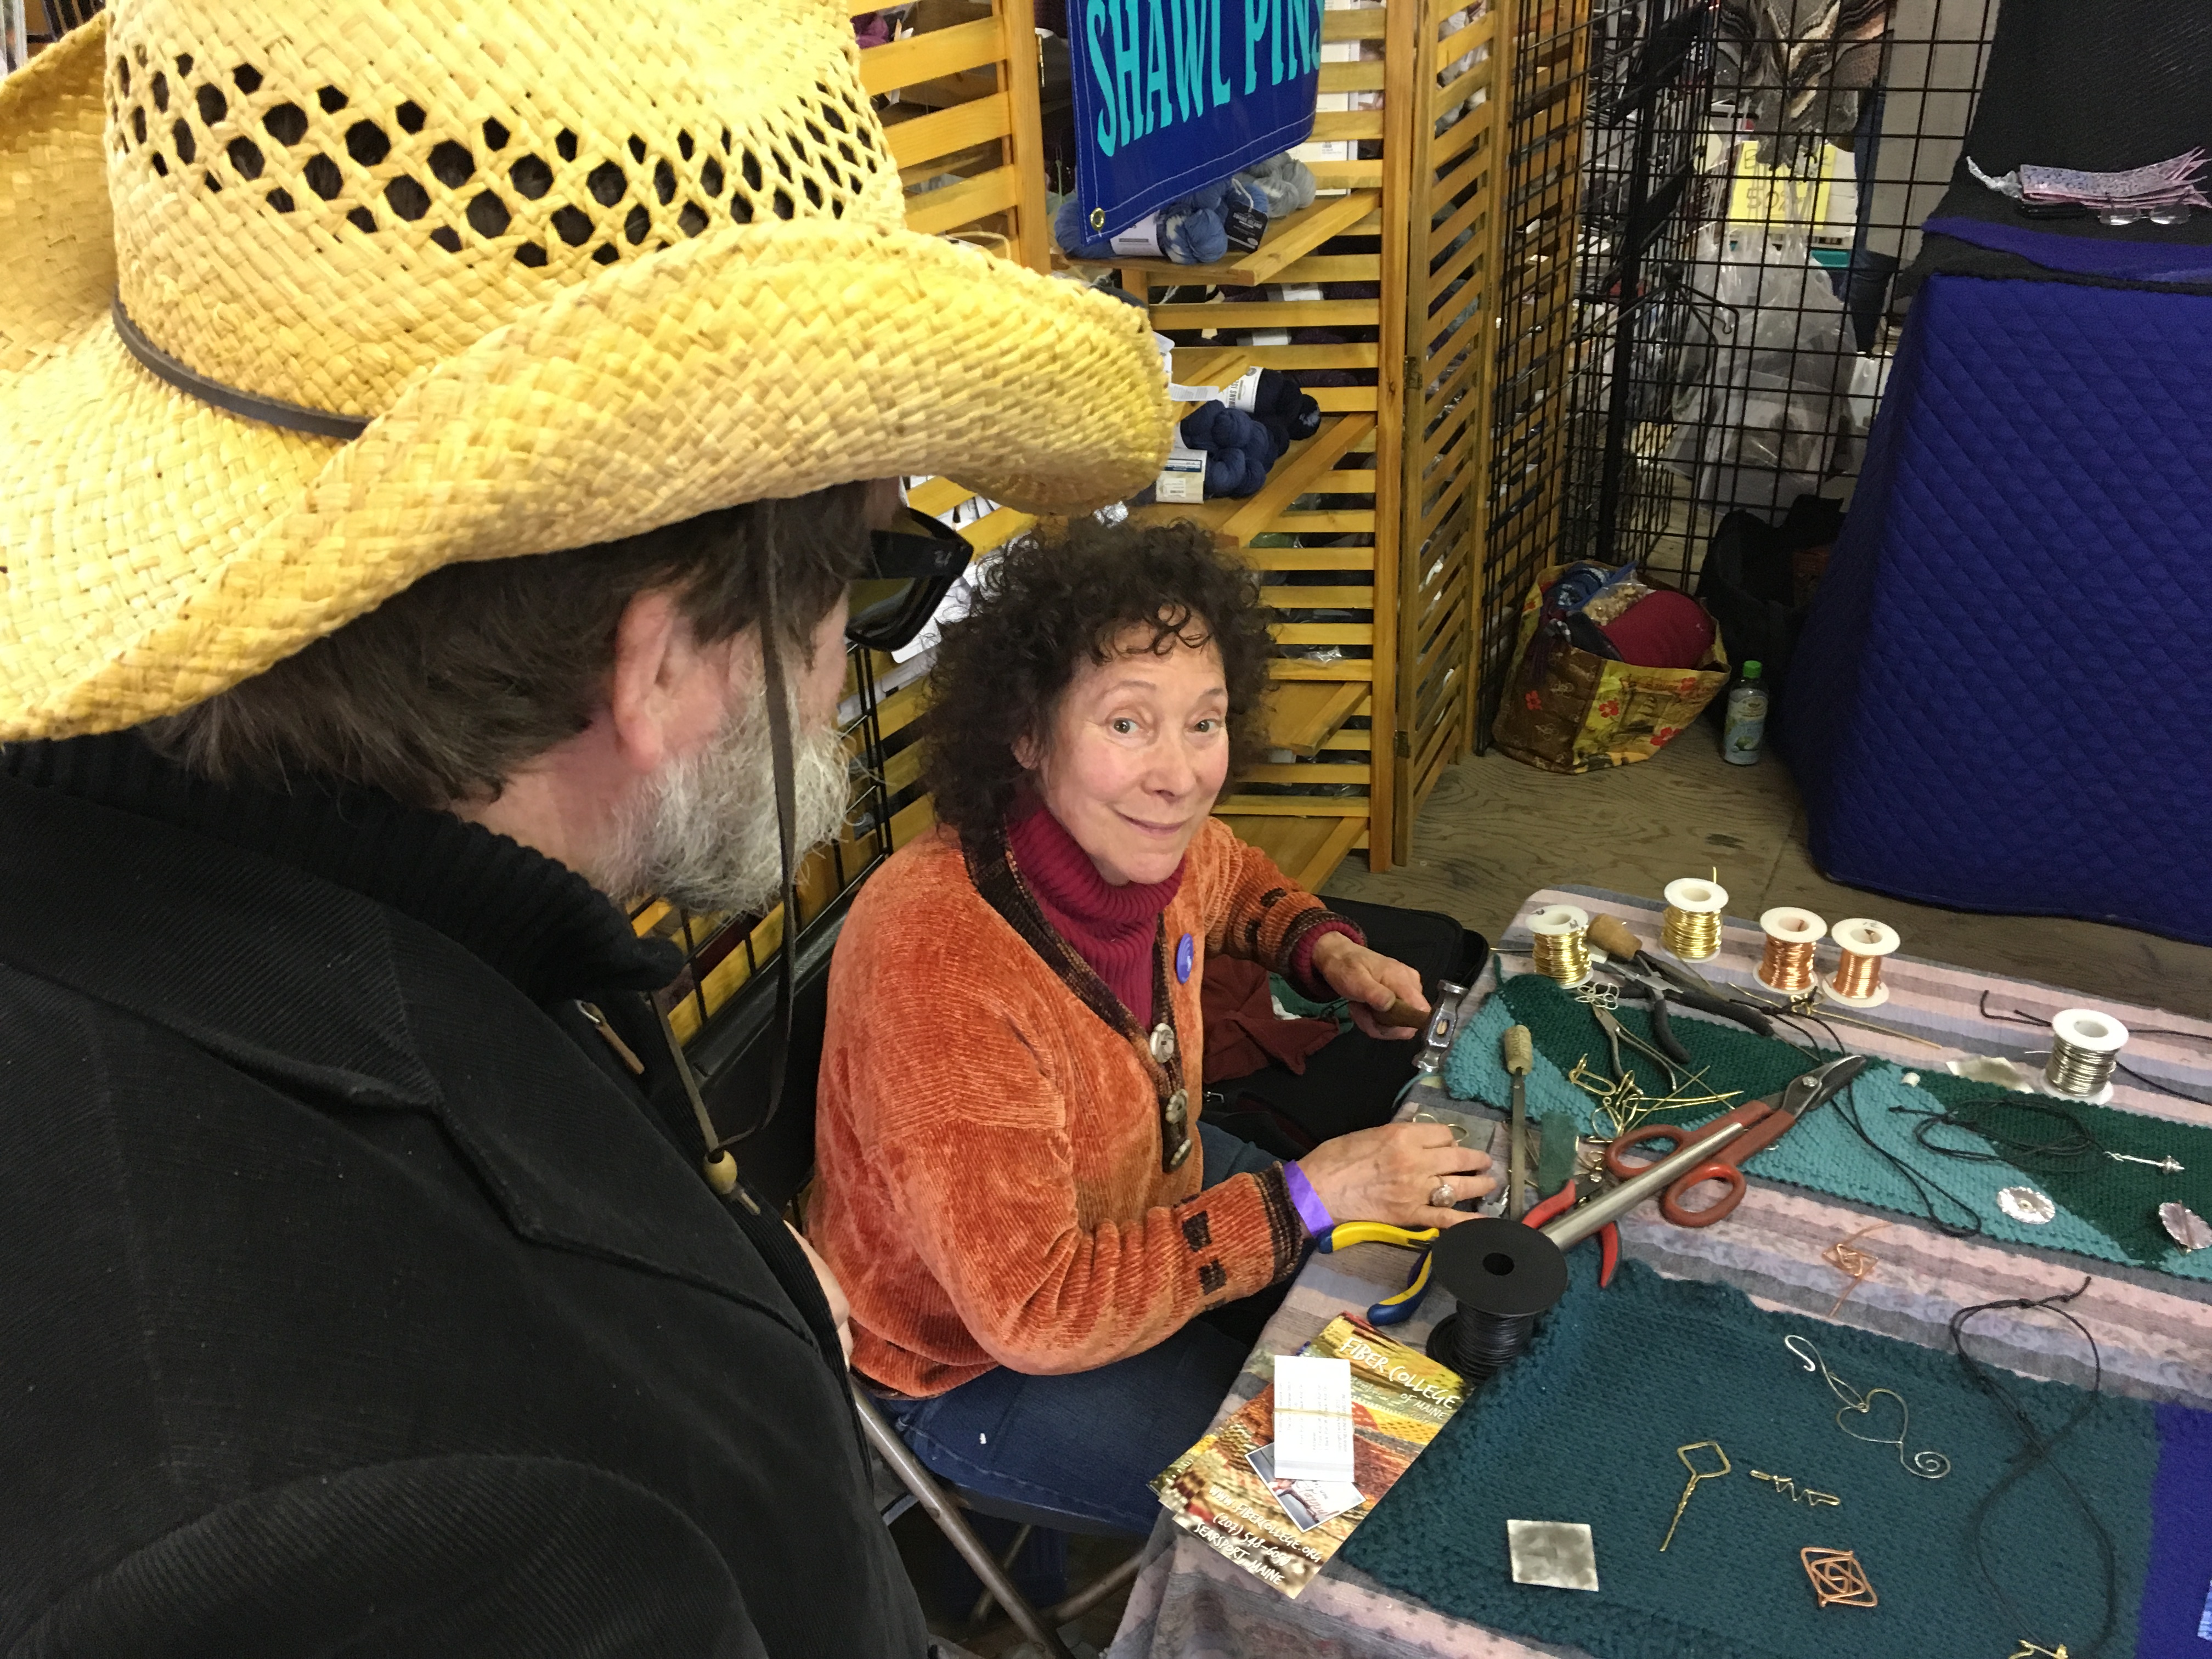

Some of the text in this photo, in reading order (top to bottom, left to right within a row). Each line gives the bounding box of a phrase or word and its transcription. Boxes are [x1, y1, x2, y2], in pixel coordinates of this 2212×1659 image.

[1087, 0, 1231, 157] SHAWL
[1340, 1337, 1461, 1409] FIBER COLLEGE
[1413, 1400, 1448, 1420] MAINE
[1212, 1513, 1244, 1536] (207)
[1250, 1559, 1285, 1585] MAINE
